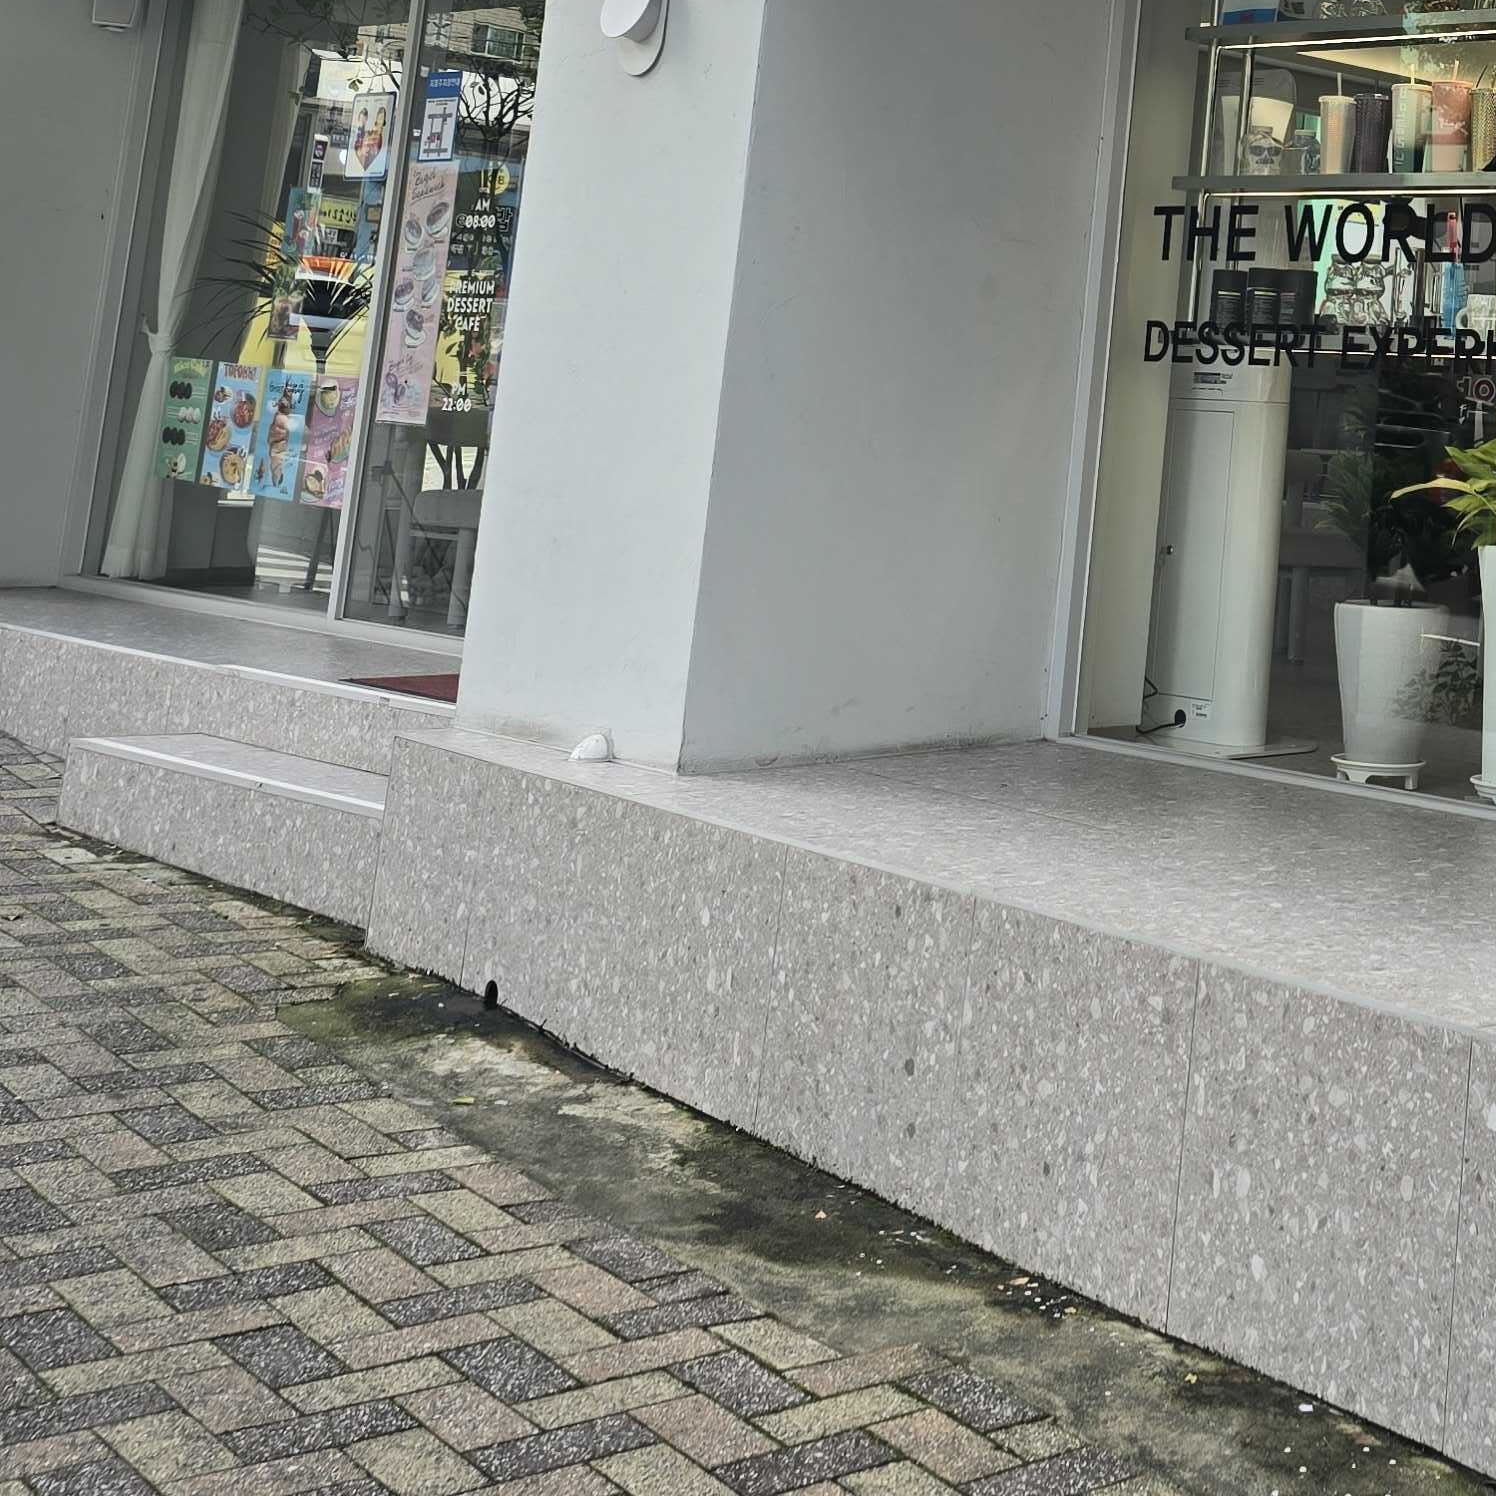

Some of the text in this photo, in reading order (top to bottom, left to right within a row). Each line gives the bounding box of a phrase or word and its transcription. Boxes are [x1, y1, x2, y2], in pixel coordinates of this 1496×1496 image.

[475, 198, 491, 212] AM
[1154, 204, 1259, 262] THE
[449, 279, 495, 296] PREMIUM
[447, 297, 493, 314] DESSERT
[1144, 320, 1323, 368] DESSERT
[452, 384, 466, 396] PM
[442, 397, 472, 413] 22:00
